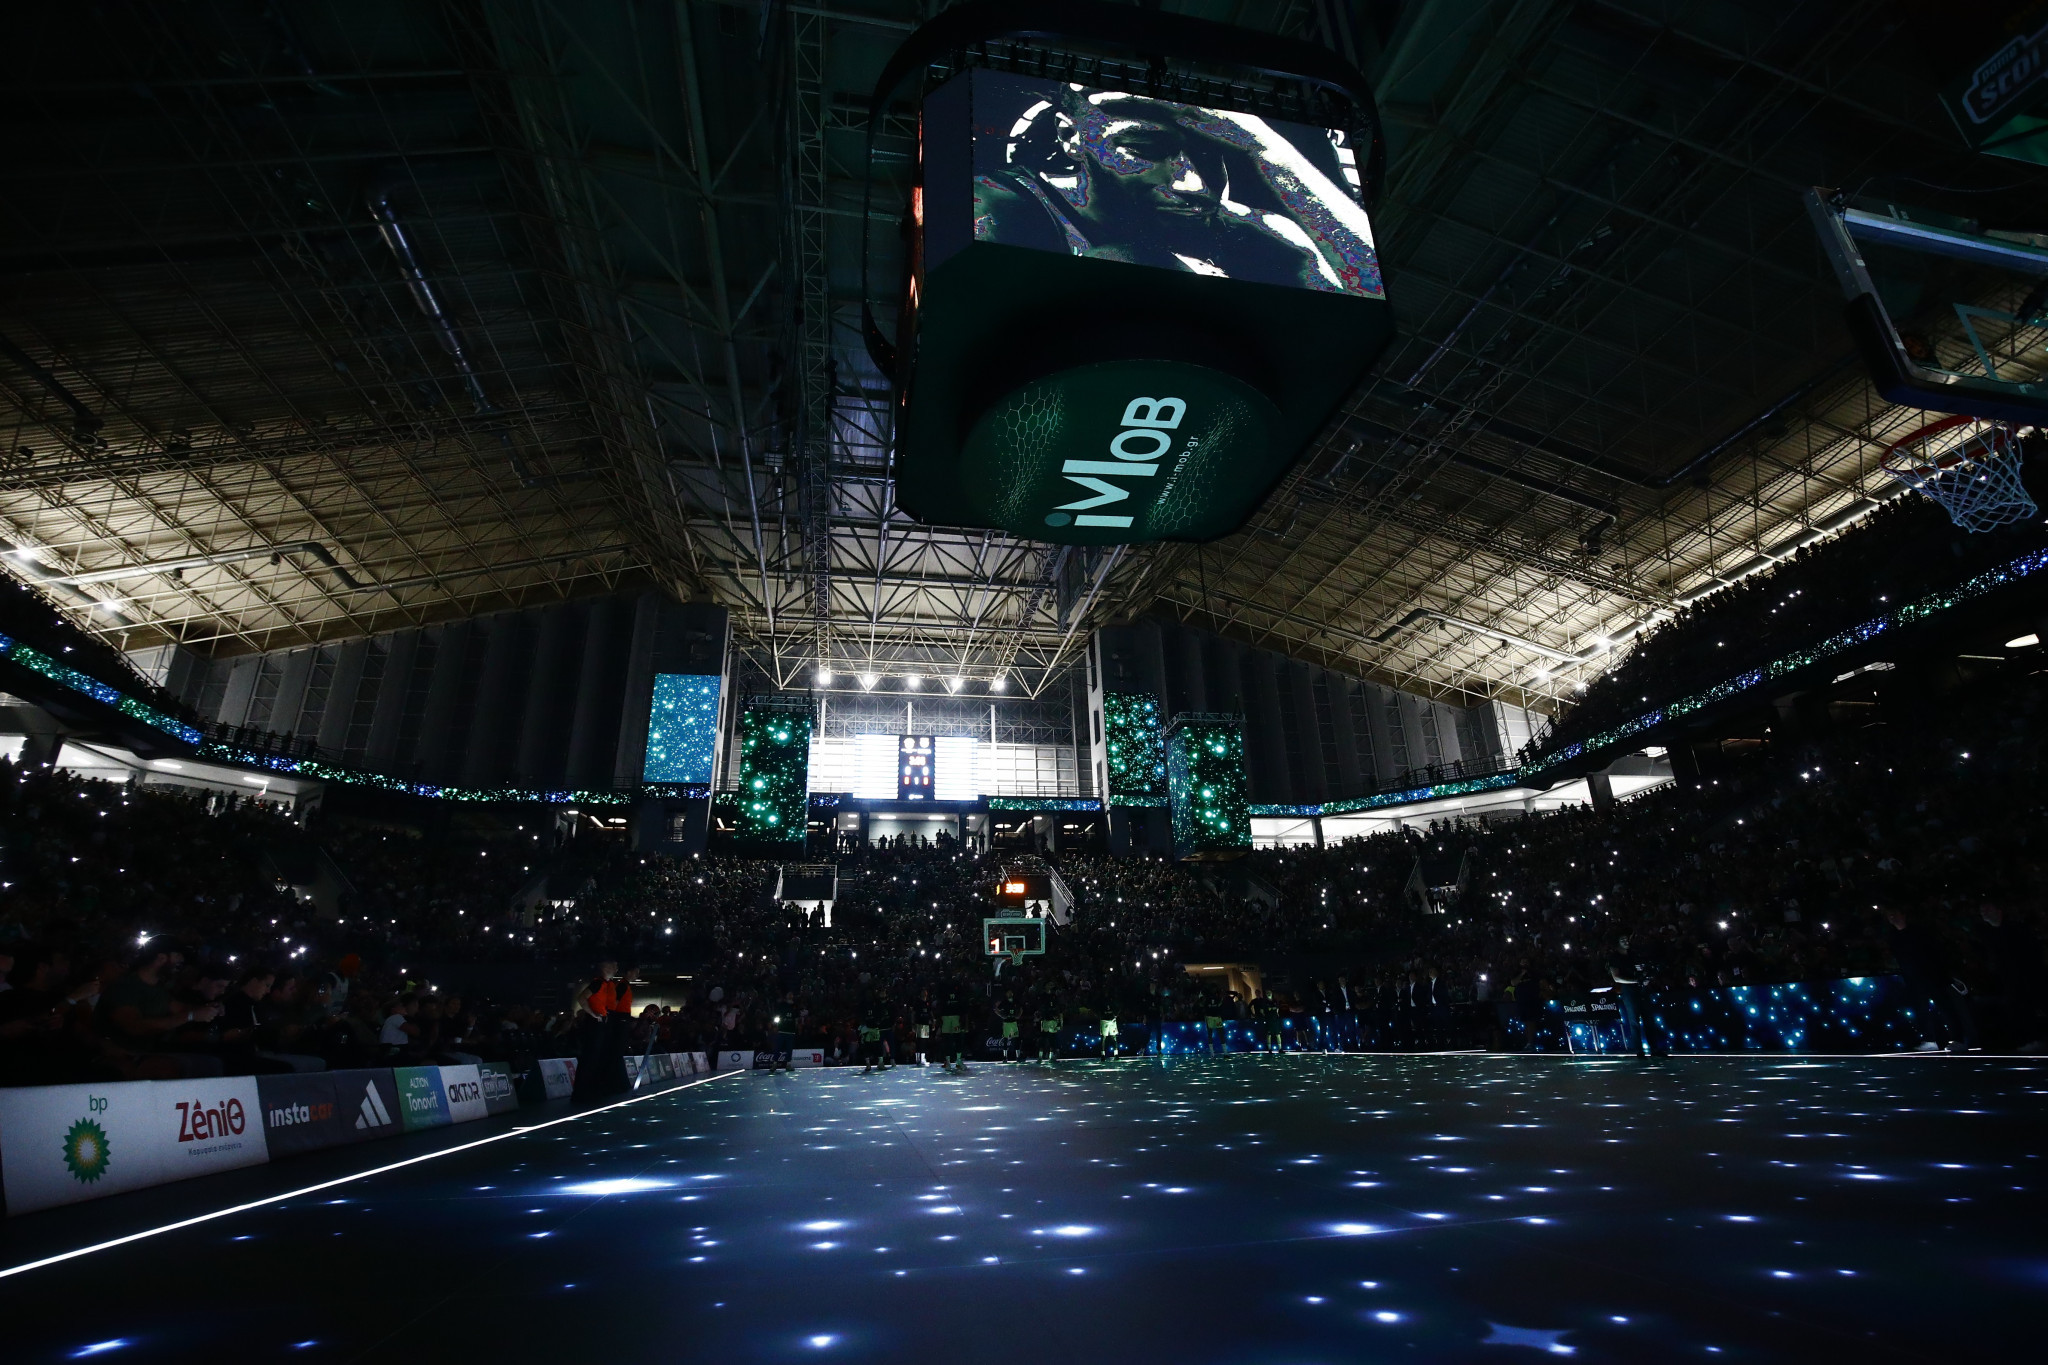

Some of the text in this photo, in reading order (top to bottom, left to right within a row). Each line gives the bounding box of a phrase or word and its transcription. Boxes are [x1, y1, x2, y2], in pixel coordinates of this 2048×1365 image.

[1157, 434, 1200, 506] www.i-mob.gr
[1591, 1003, 1617, 1011] SPALDING
[89, 1094, 108, 1115] bp
[268, 1101, 334, 1128] instacar
